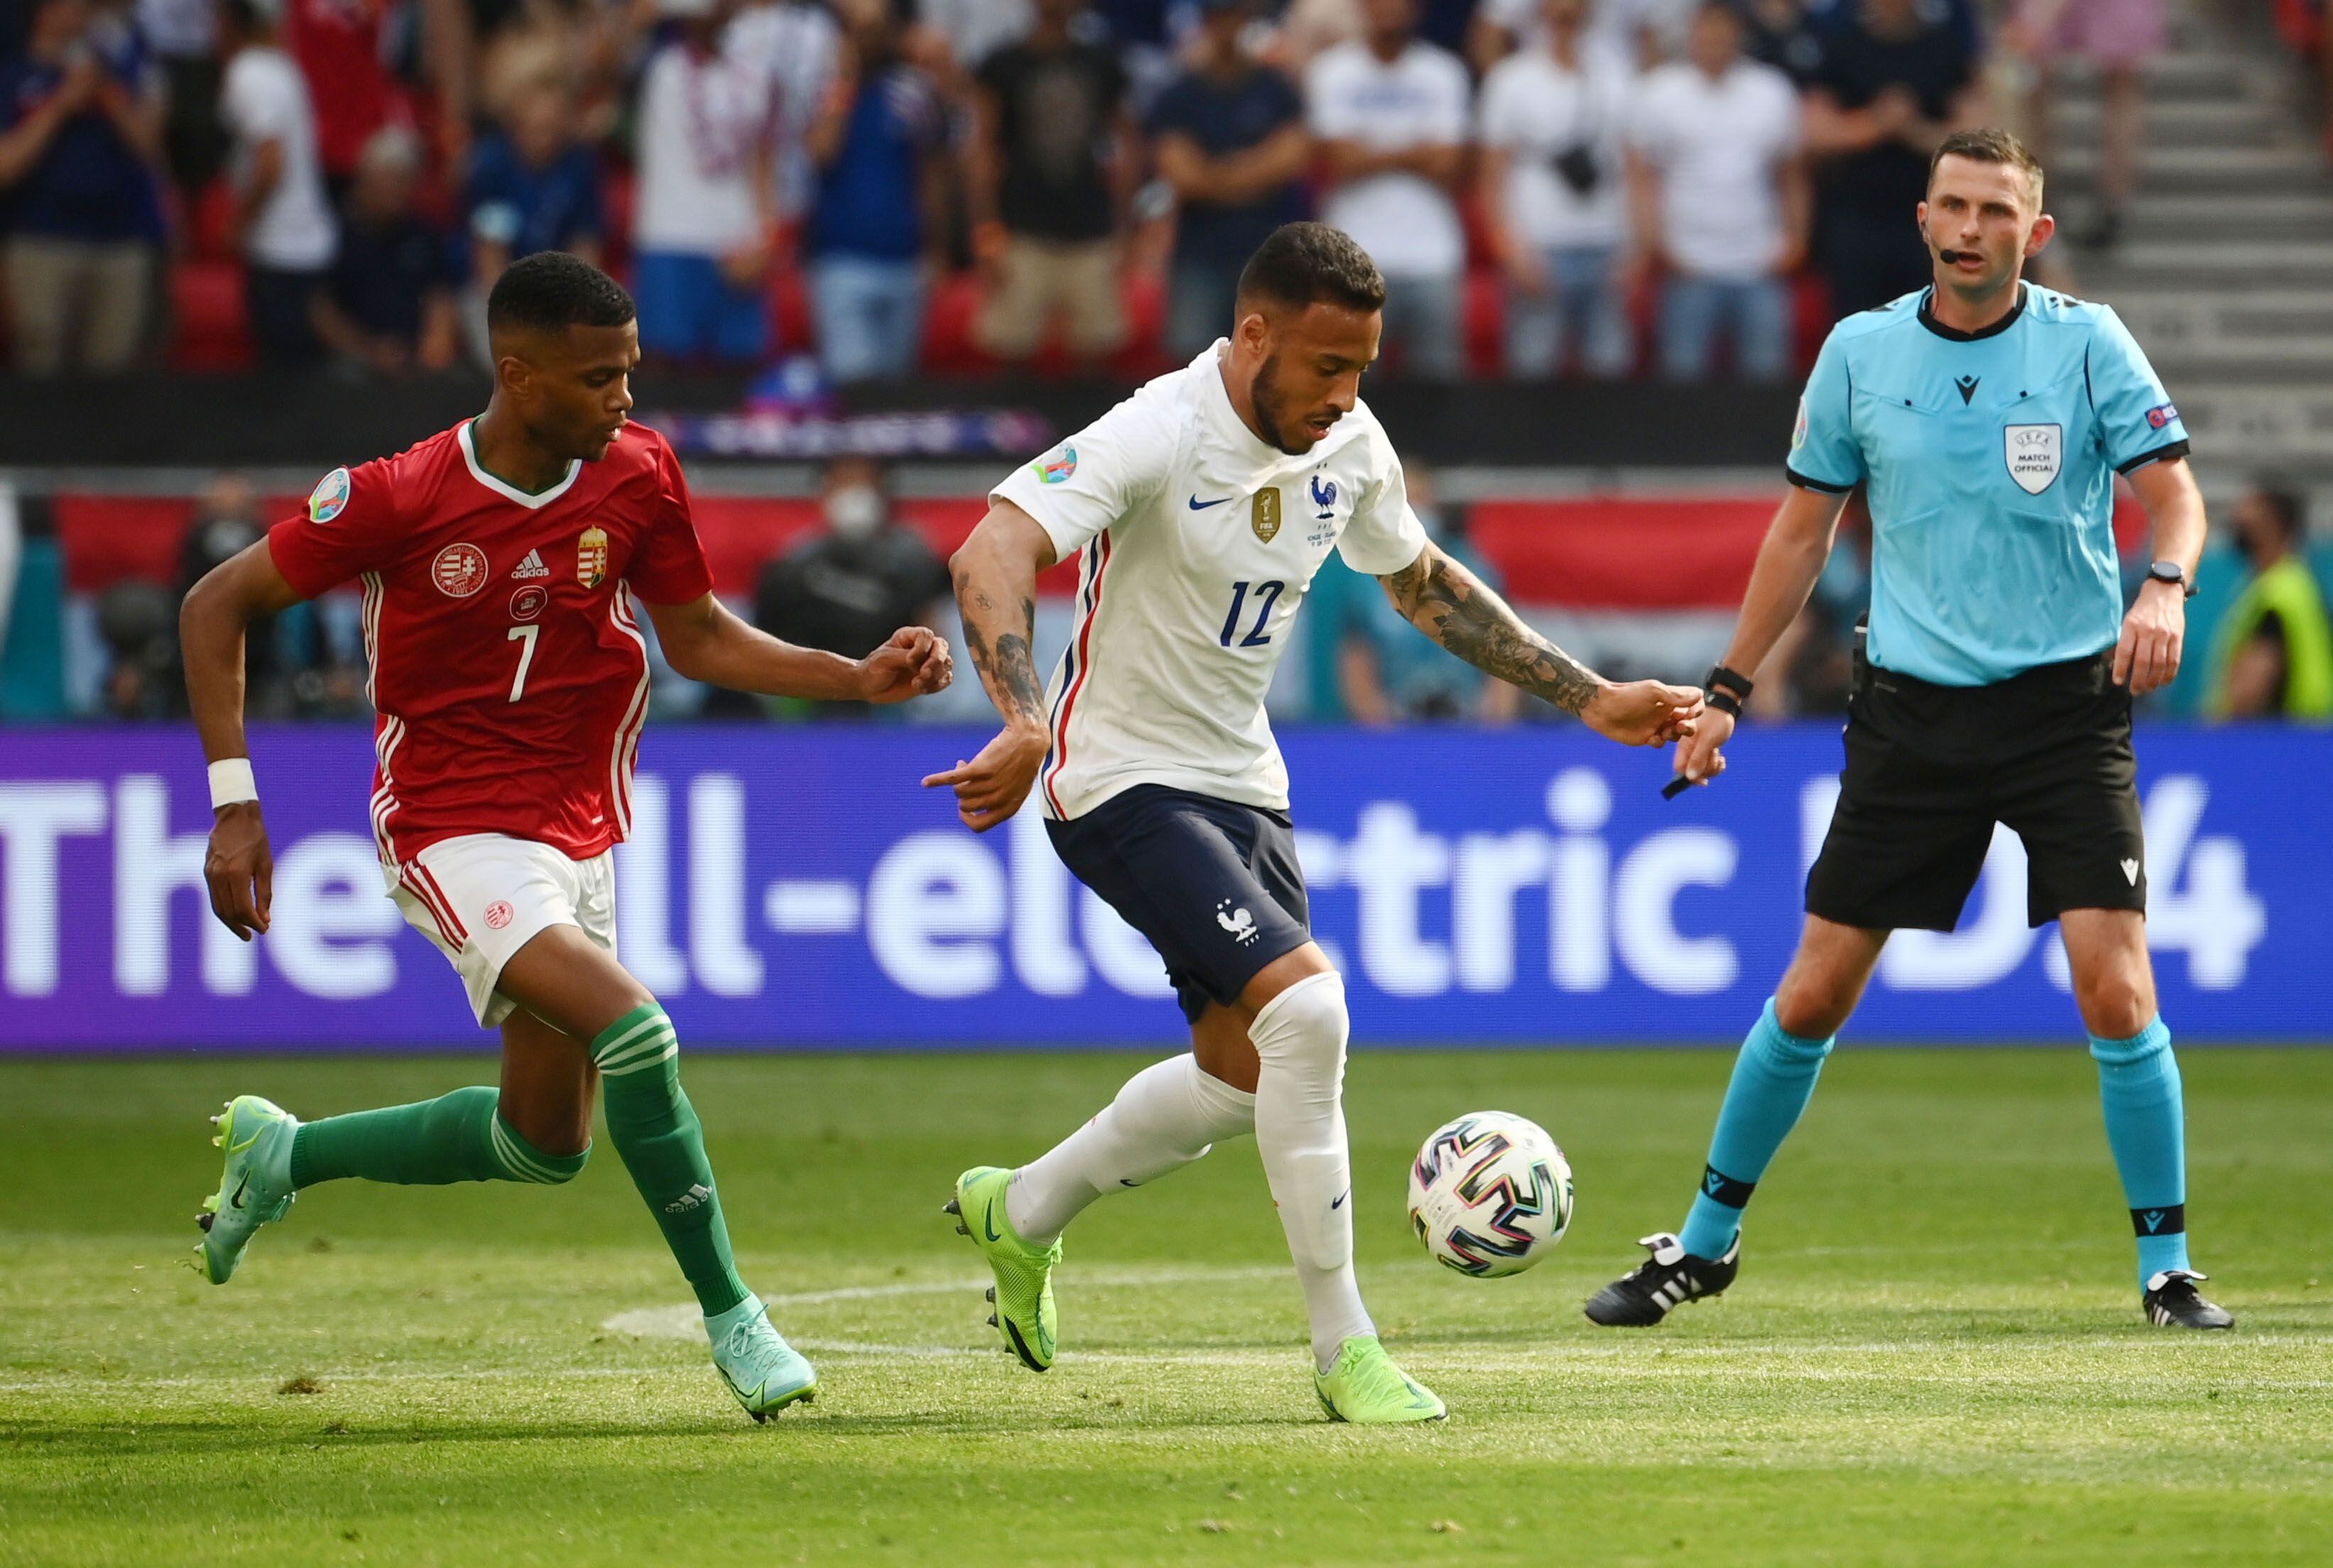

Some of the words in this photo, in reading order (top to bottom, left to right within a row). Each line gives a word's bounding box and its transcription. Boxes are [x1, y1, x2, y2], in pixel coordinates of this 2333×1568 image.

[2014, 464, 2053, 473] OFFICIAL
[511, 567, 550, 579] adidas
[1220, 580, 1285, 647] 12
[507, 624, 540, 703] 7
[0, 773, 403, 999] The
